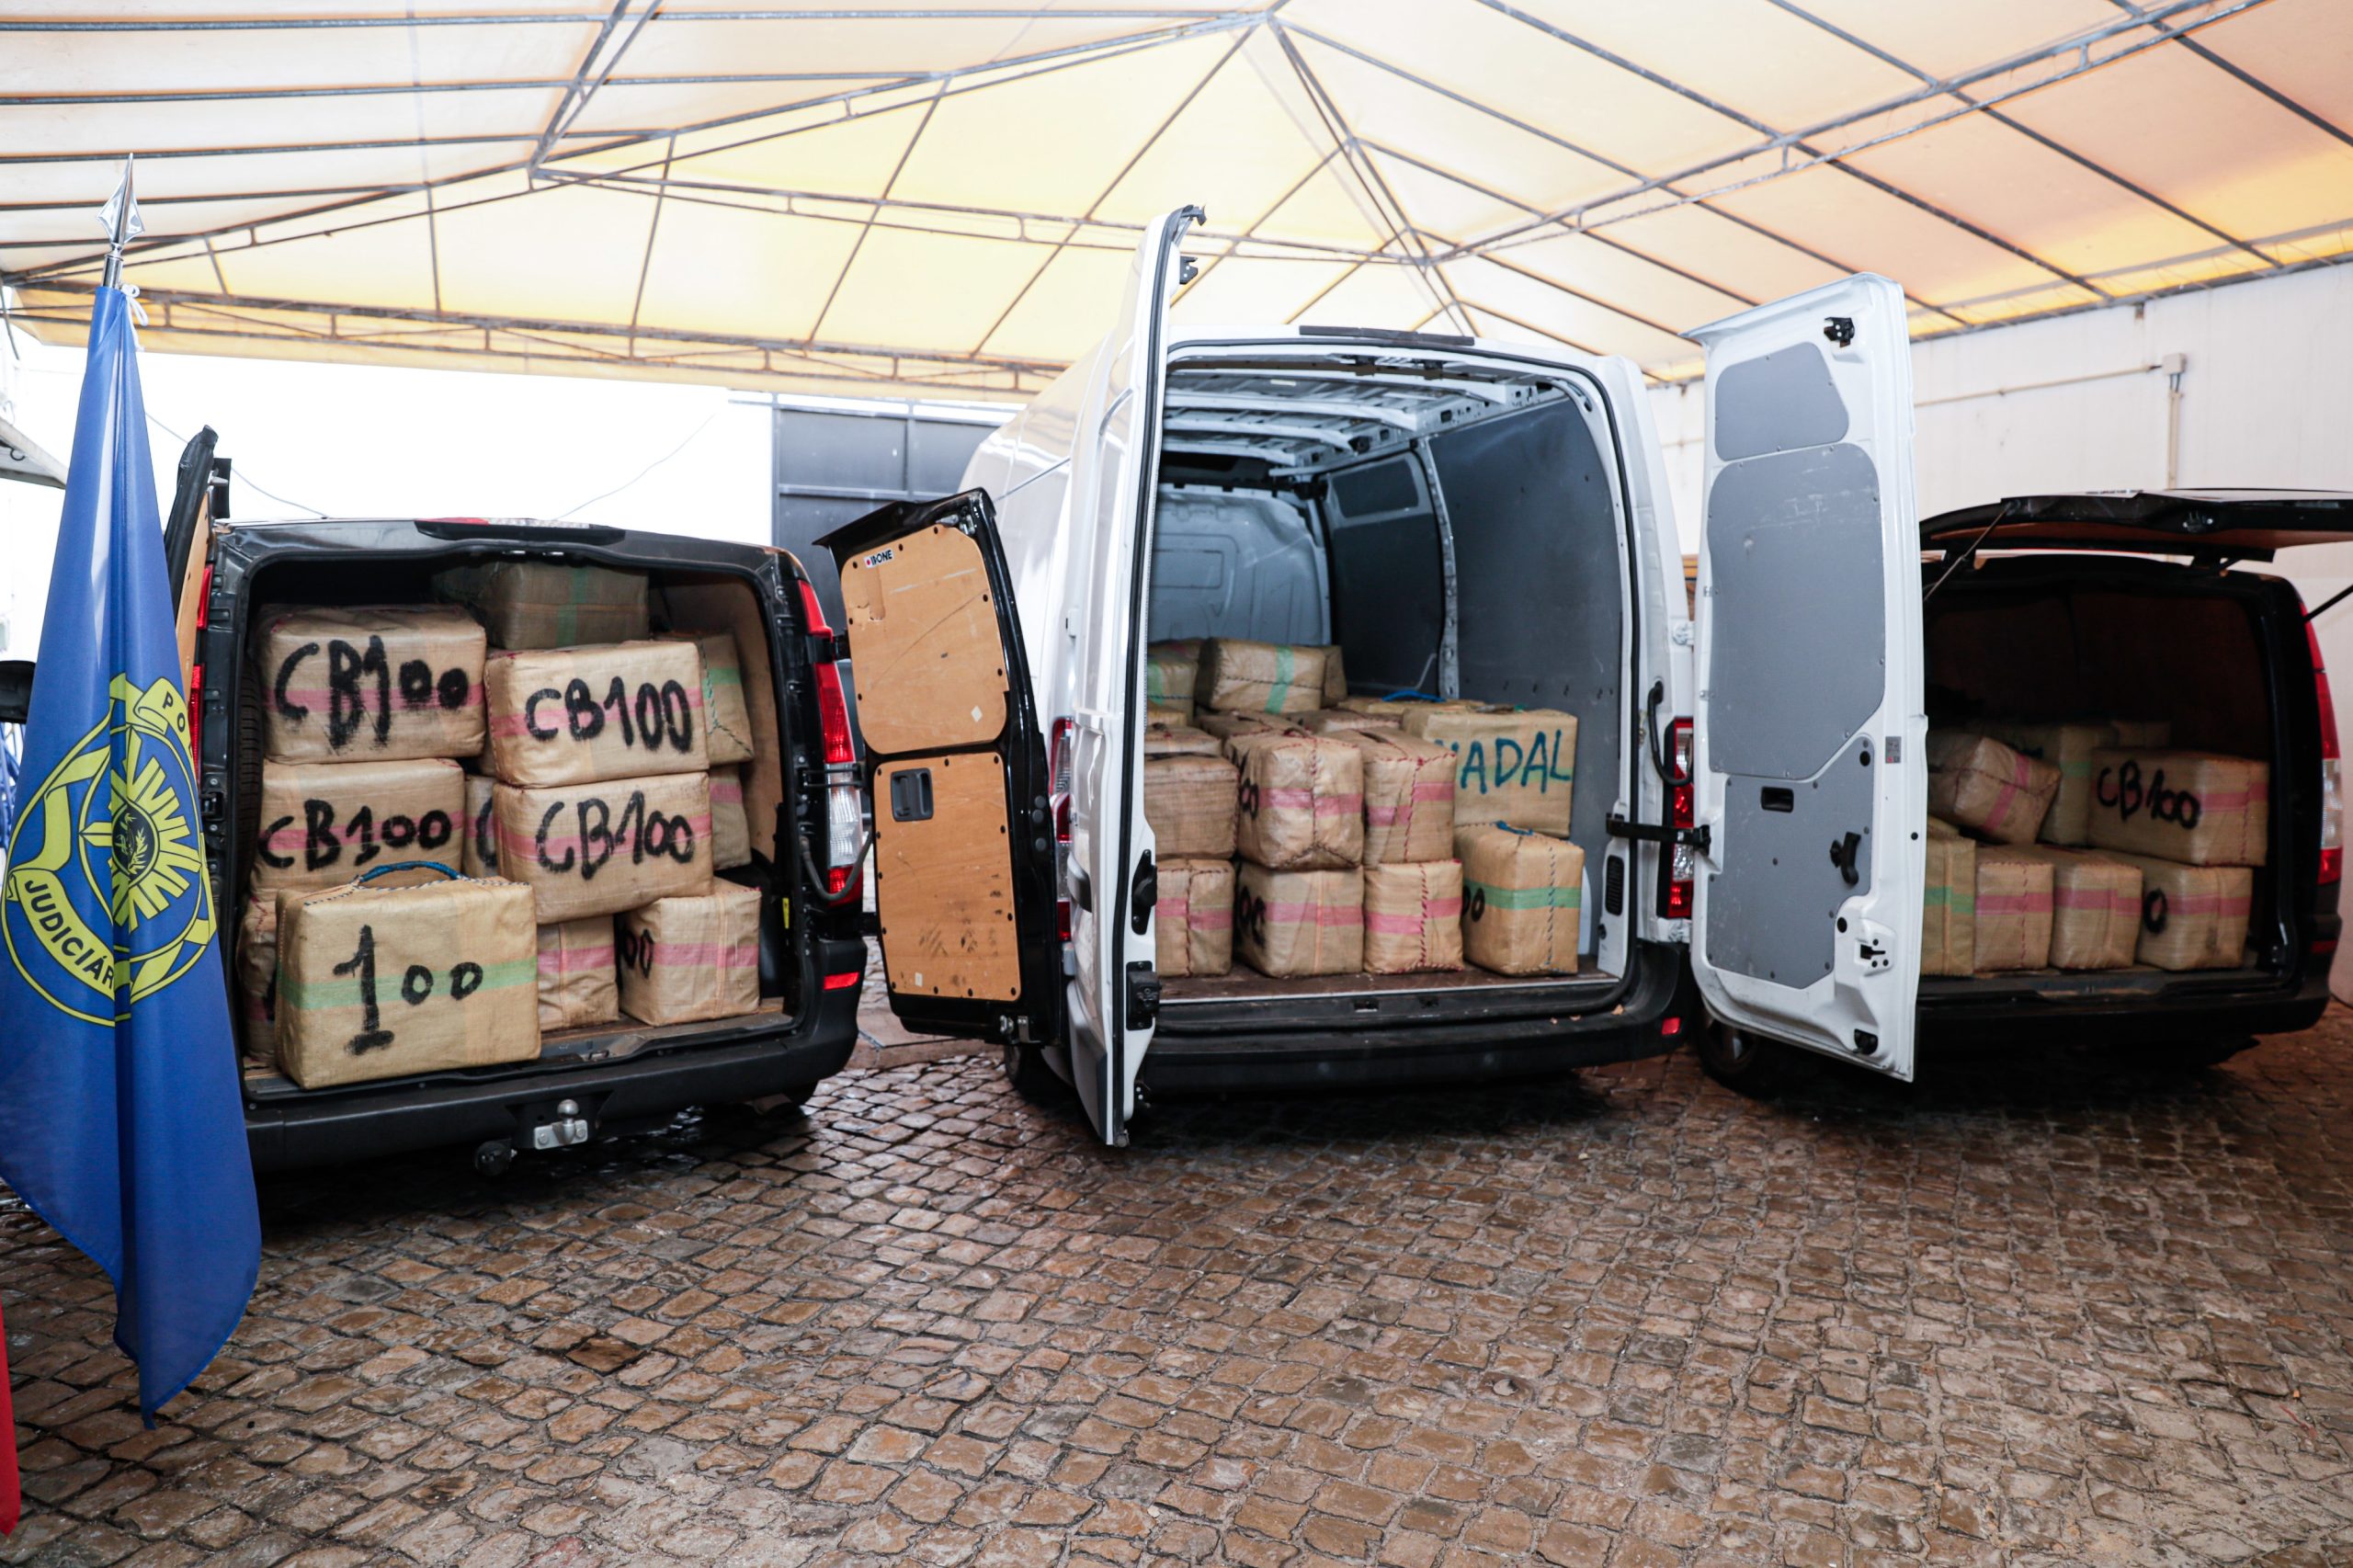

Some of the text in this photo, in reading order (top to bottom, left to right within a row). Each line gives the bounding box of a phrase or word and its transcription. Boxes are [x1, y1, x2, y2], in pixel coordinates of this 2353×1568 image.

[277, 634, 470, 756] CB100
[524, 676, 692, 754] CB100
[258, 798, 453, 872] CB100
[535, 790, 696, 881] CB100
[2097, 759, 2200, 829] CB100
[24, 880, 115, 990] JUDICIÁR
[333, 924, 484, 1057] 100
